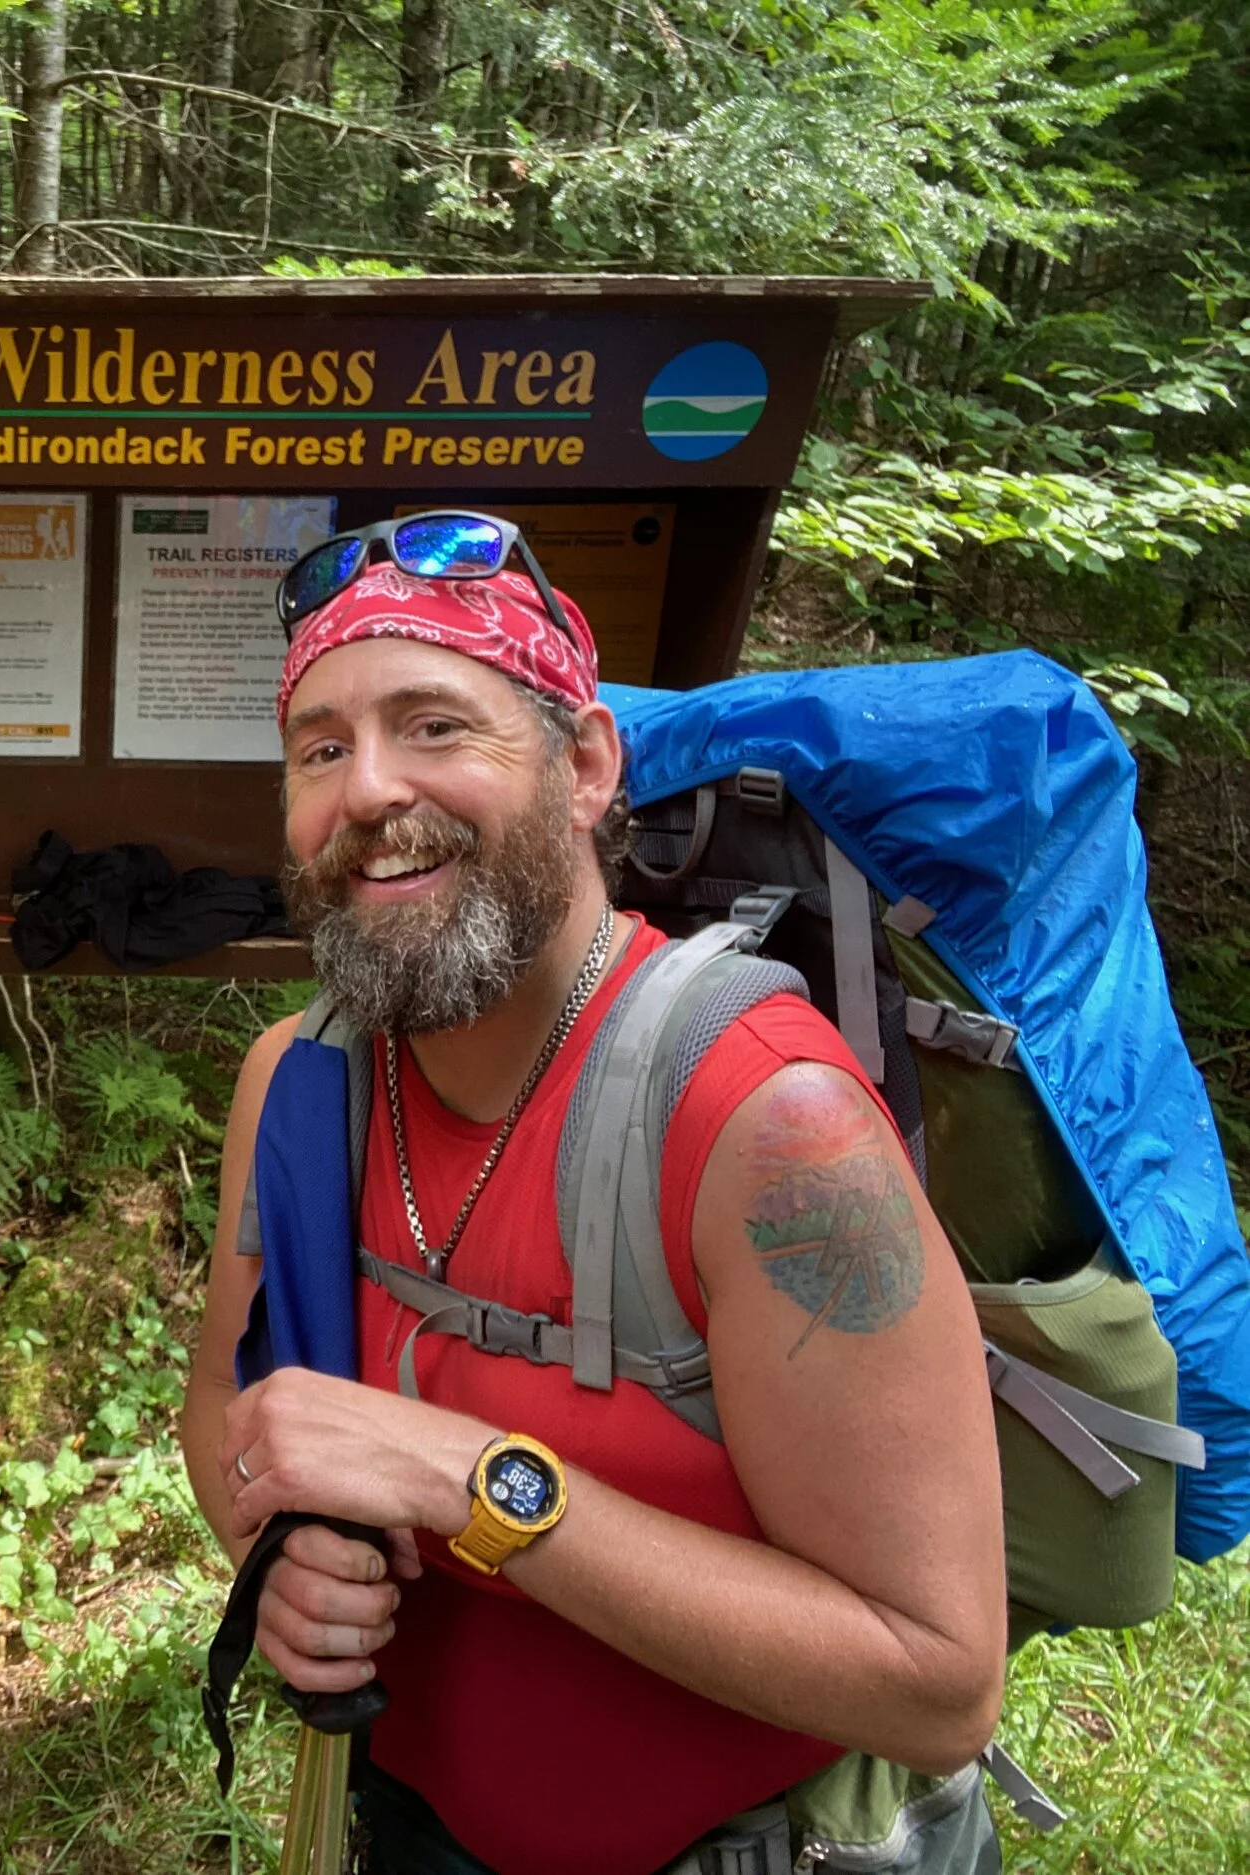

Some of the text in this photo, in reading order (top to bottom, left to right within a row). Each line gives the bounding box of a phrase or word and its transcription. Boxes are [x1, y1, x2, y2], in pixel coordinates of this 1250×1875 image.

[406, 328, 597, 405] Area
[224, 427, 365, 466] Forest
[383, 428, 584, 465] Preserve
[148, 548, 300, 562] TRAIL REGISTERS
[153, 567, 210, 579] PREVENT
[214, 567, 238, 579] THE
[507, 1468, 540, 1498] 2:38
